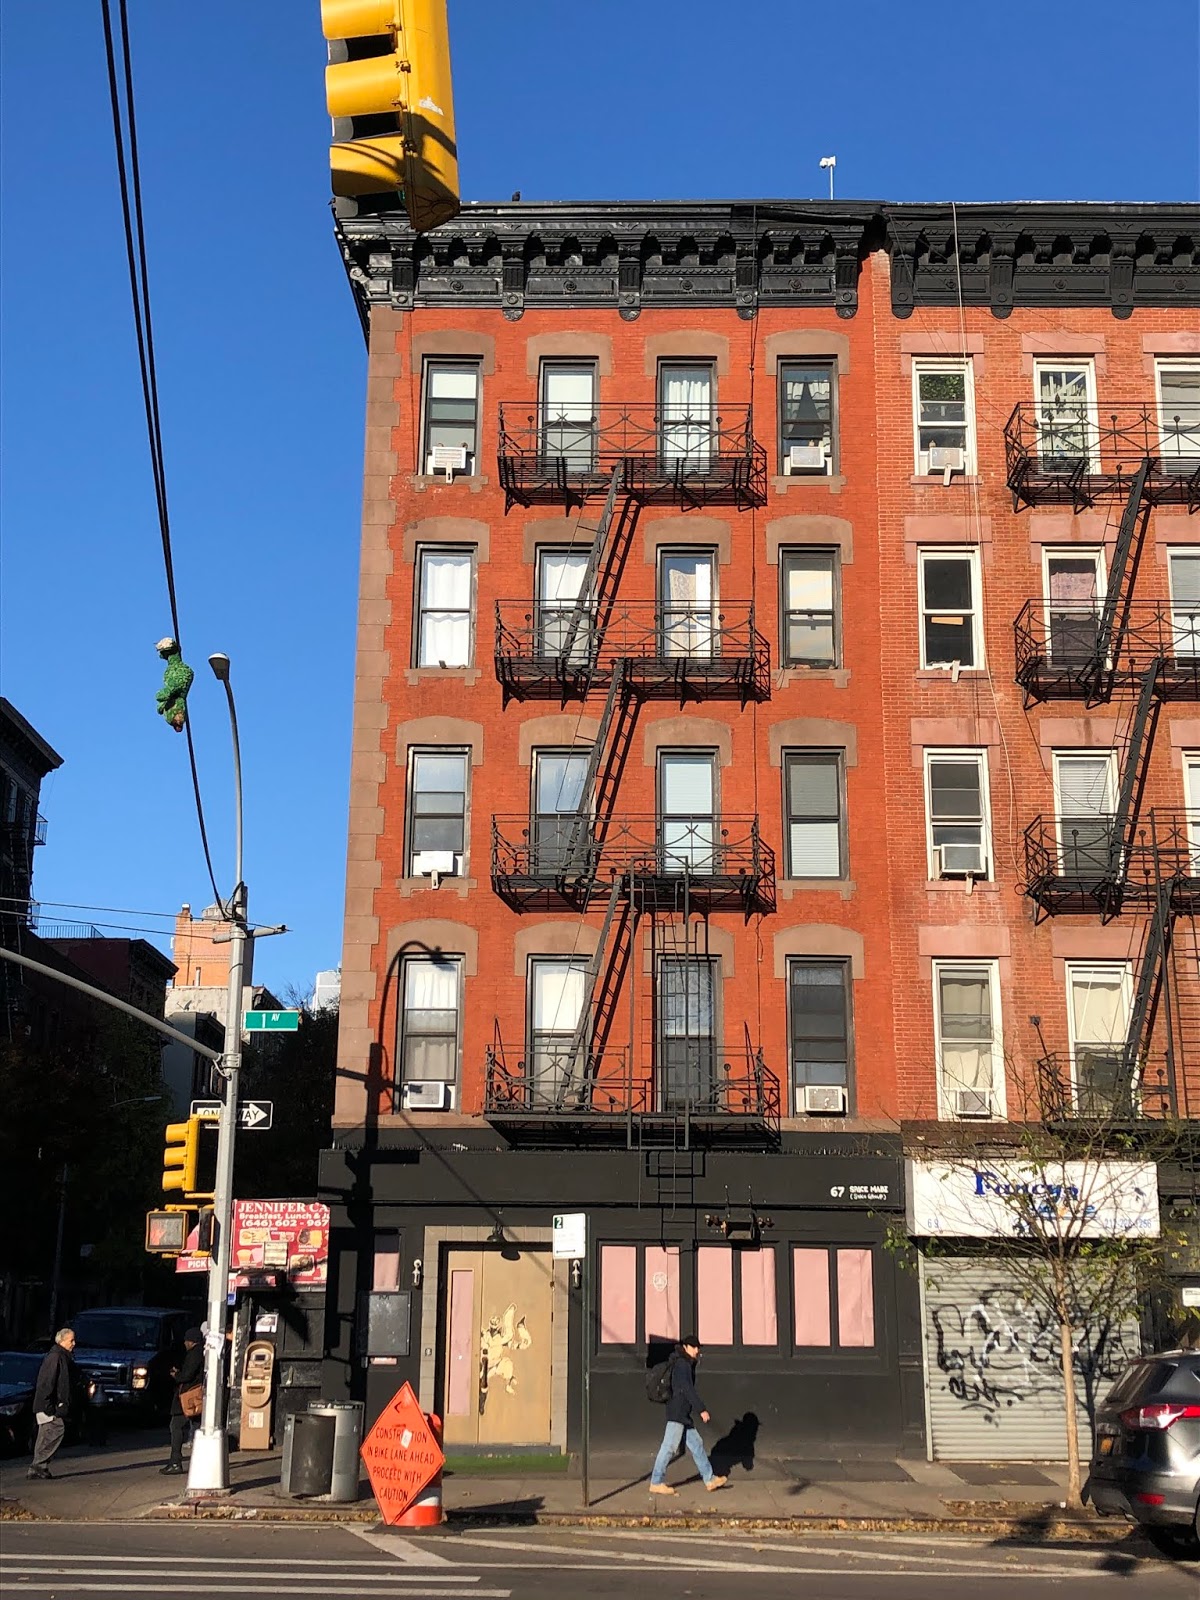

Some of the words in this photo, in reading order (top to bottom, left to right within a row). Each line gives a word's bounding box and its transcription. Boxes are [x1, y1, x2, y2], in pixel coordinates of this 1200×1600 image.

[262, 1013, 266, 1028] 1
[271, 1013, 280, 1021] AV
[830, 1186, 845, 1198] 67
[238, 1202, 306, 1213] JENNIFER
[242, 1220, 273, 1228] (646)
[275, 1219, 297, 1227] 602
[556, 1216, 562, 1228] 2
[376, 1426, 428, 1443] CONSTRTION
[367, 1446, 373, 1457] IN
[374, 1446, 388, 1460] BIKE
[390, 1448, 407, 1462] LANE
[410, 1451, 435, 1465] AHEAD
[373, 1466, 402, 1481] PROCEED
[404, 1470, 422, 1484] WITH
[380, 1487, 409, 1502] CAUTION
